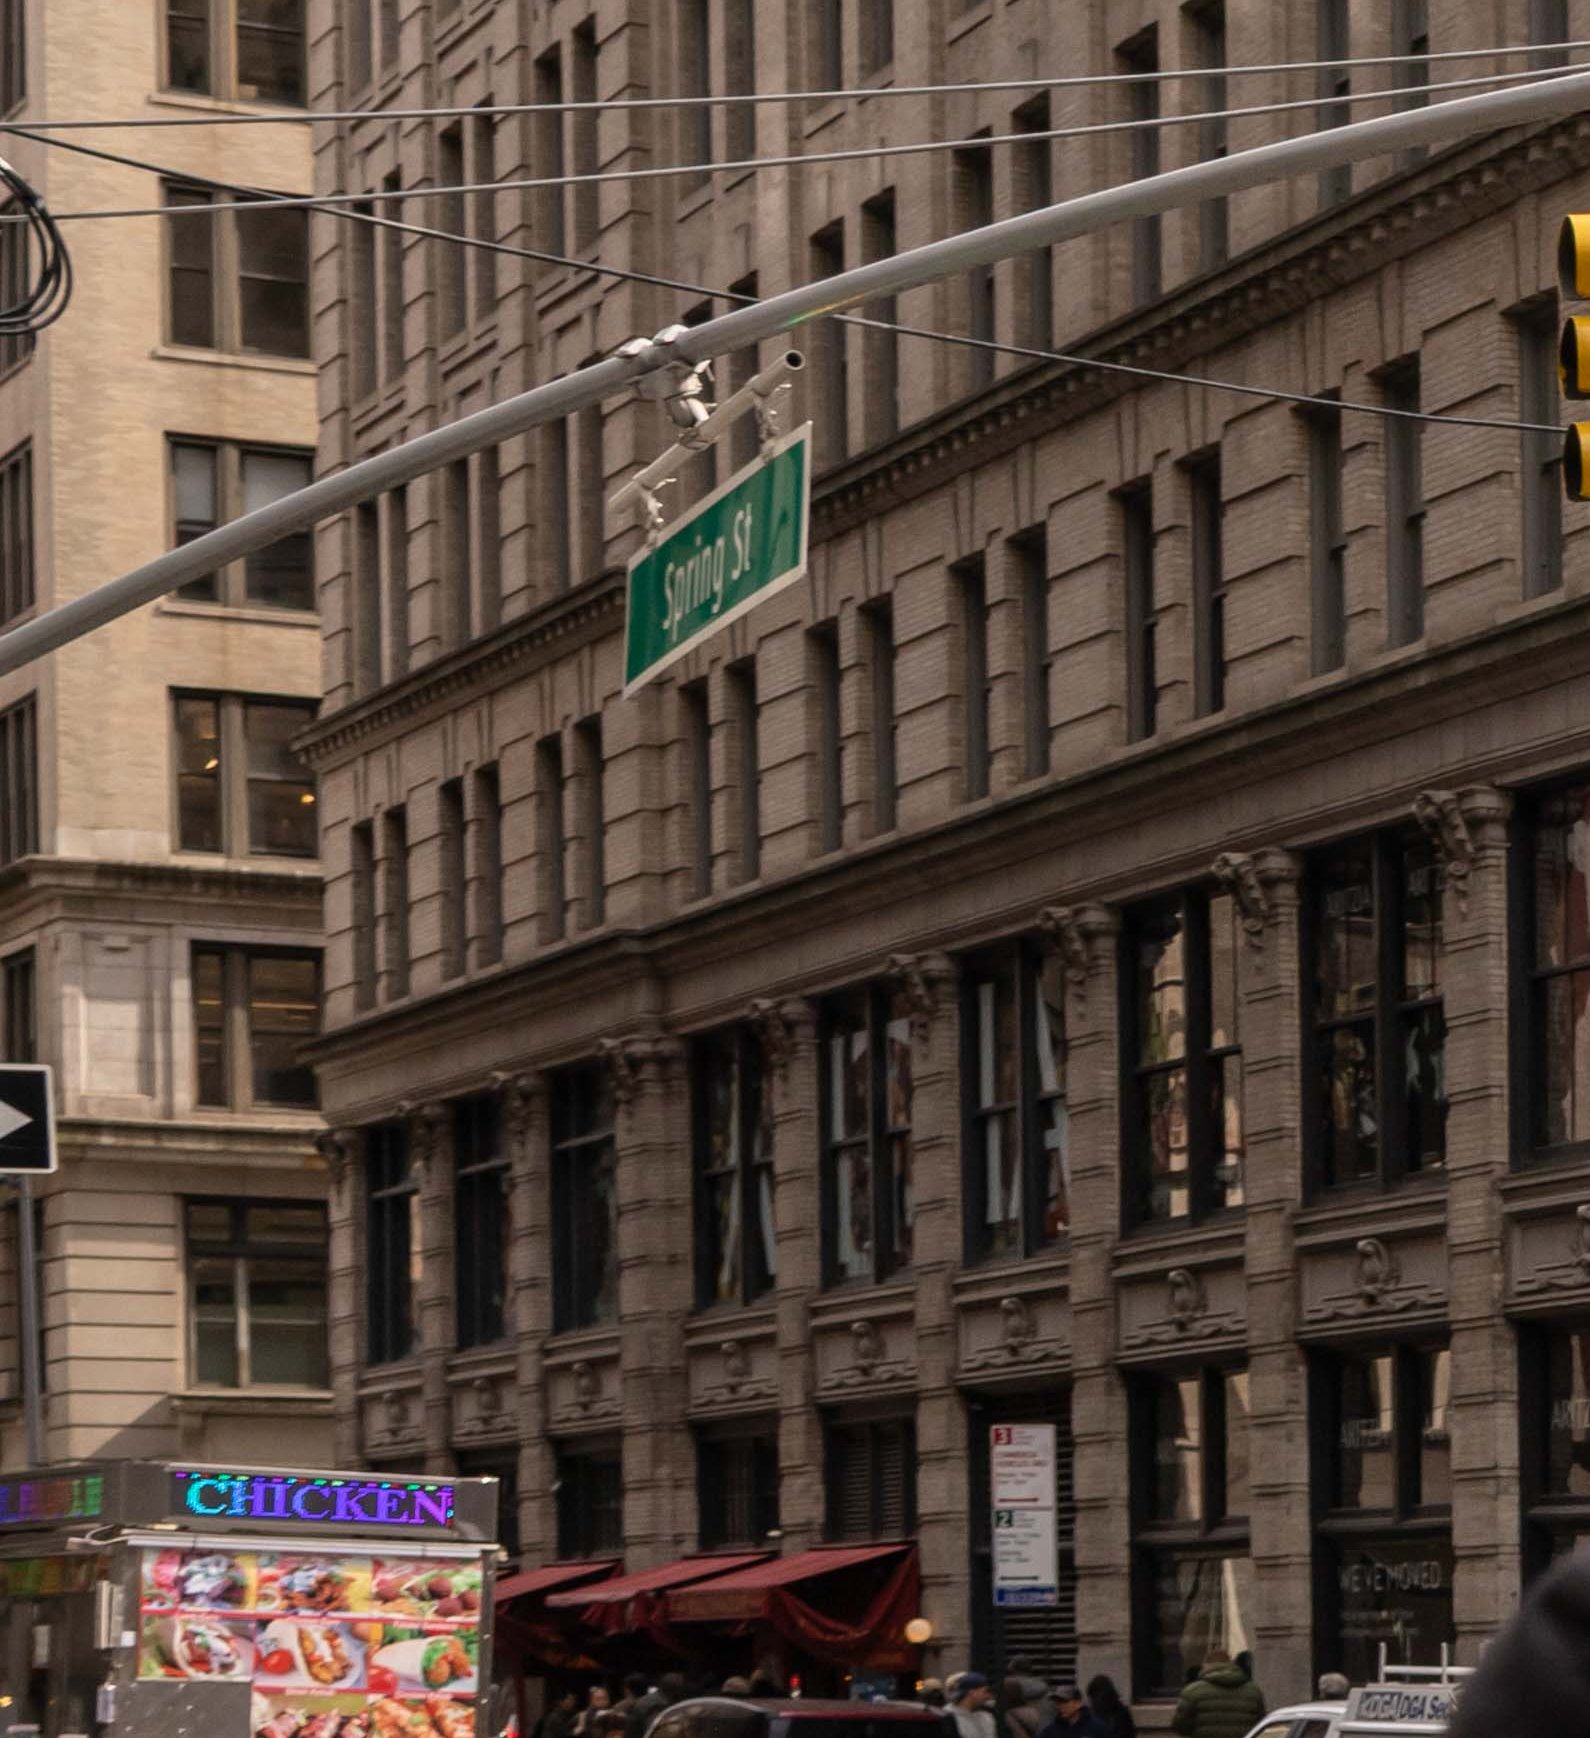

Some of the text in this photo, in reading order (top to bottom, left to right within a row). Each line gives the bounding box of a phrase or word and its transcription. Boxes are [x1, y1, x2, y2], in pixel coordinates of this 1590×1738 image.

[662, 502, 752, 643] Spring St
[186, 1478, 450, 1526] CHICKEN
